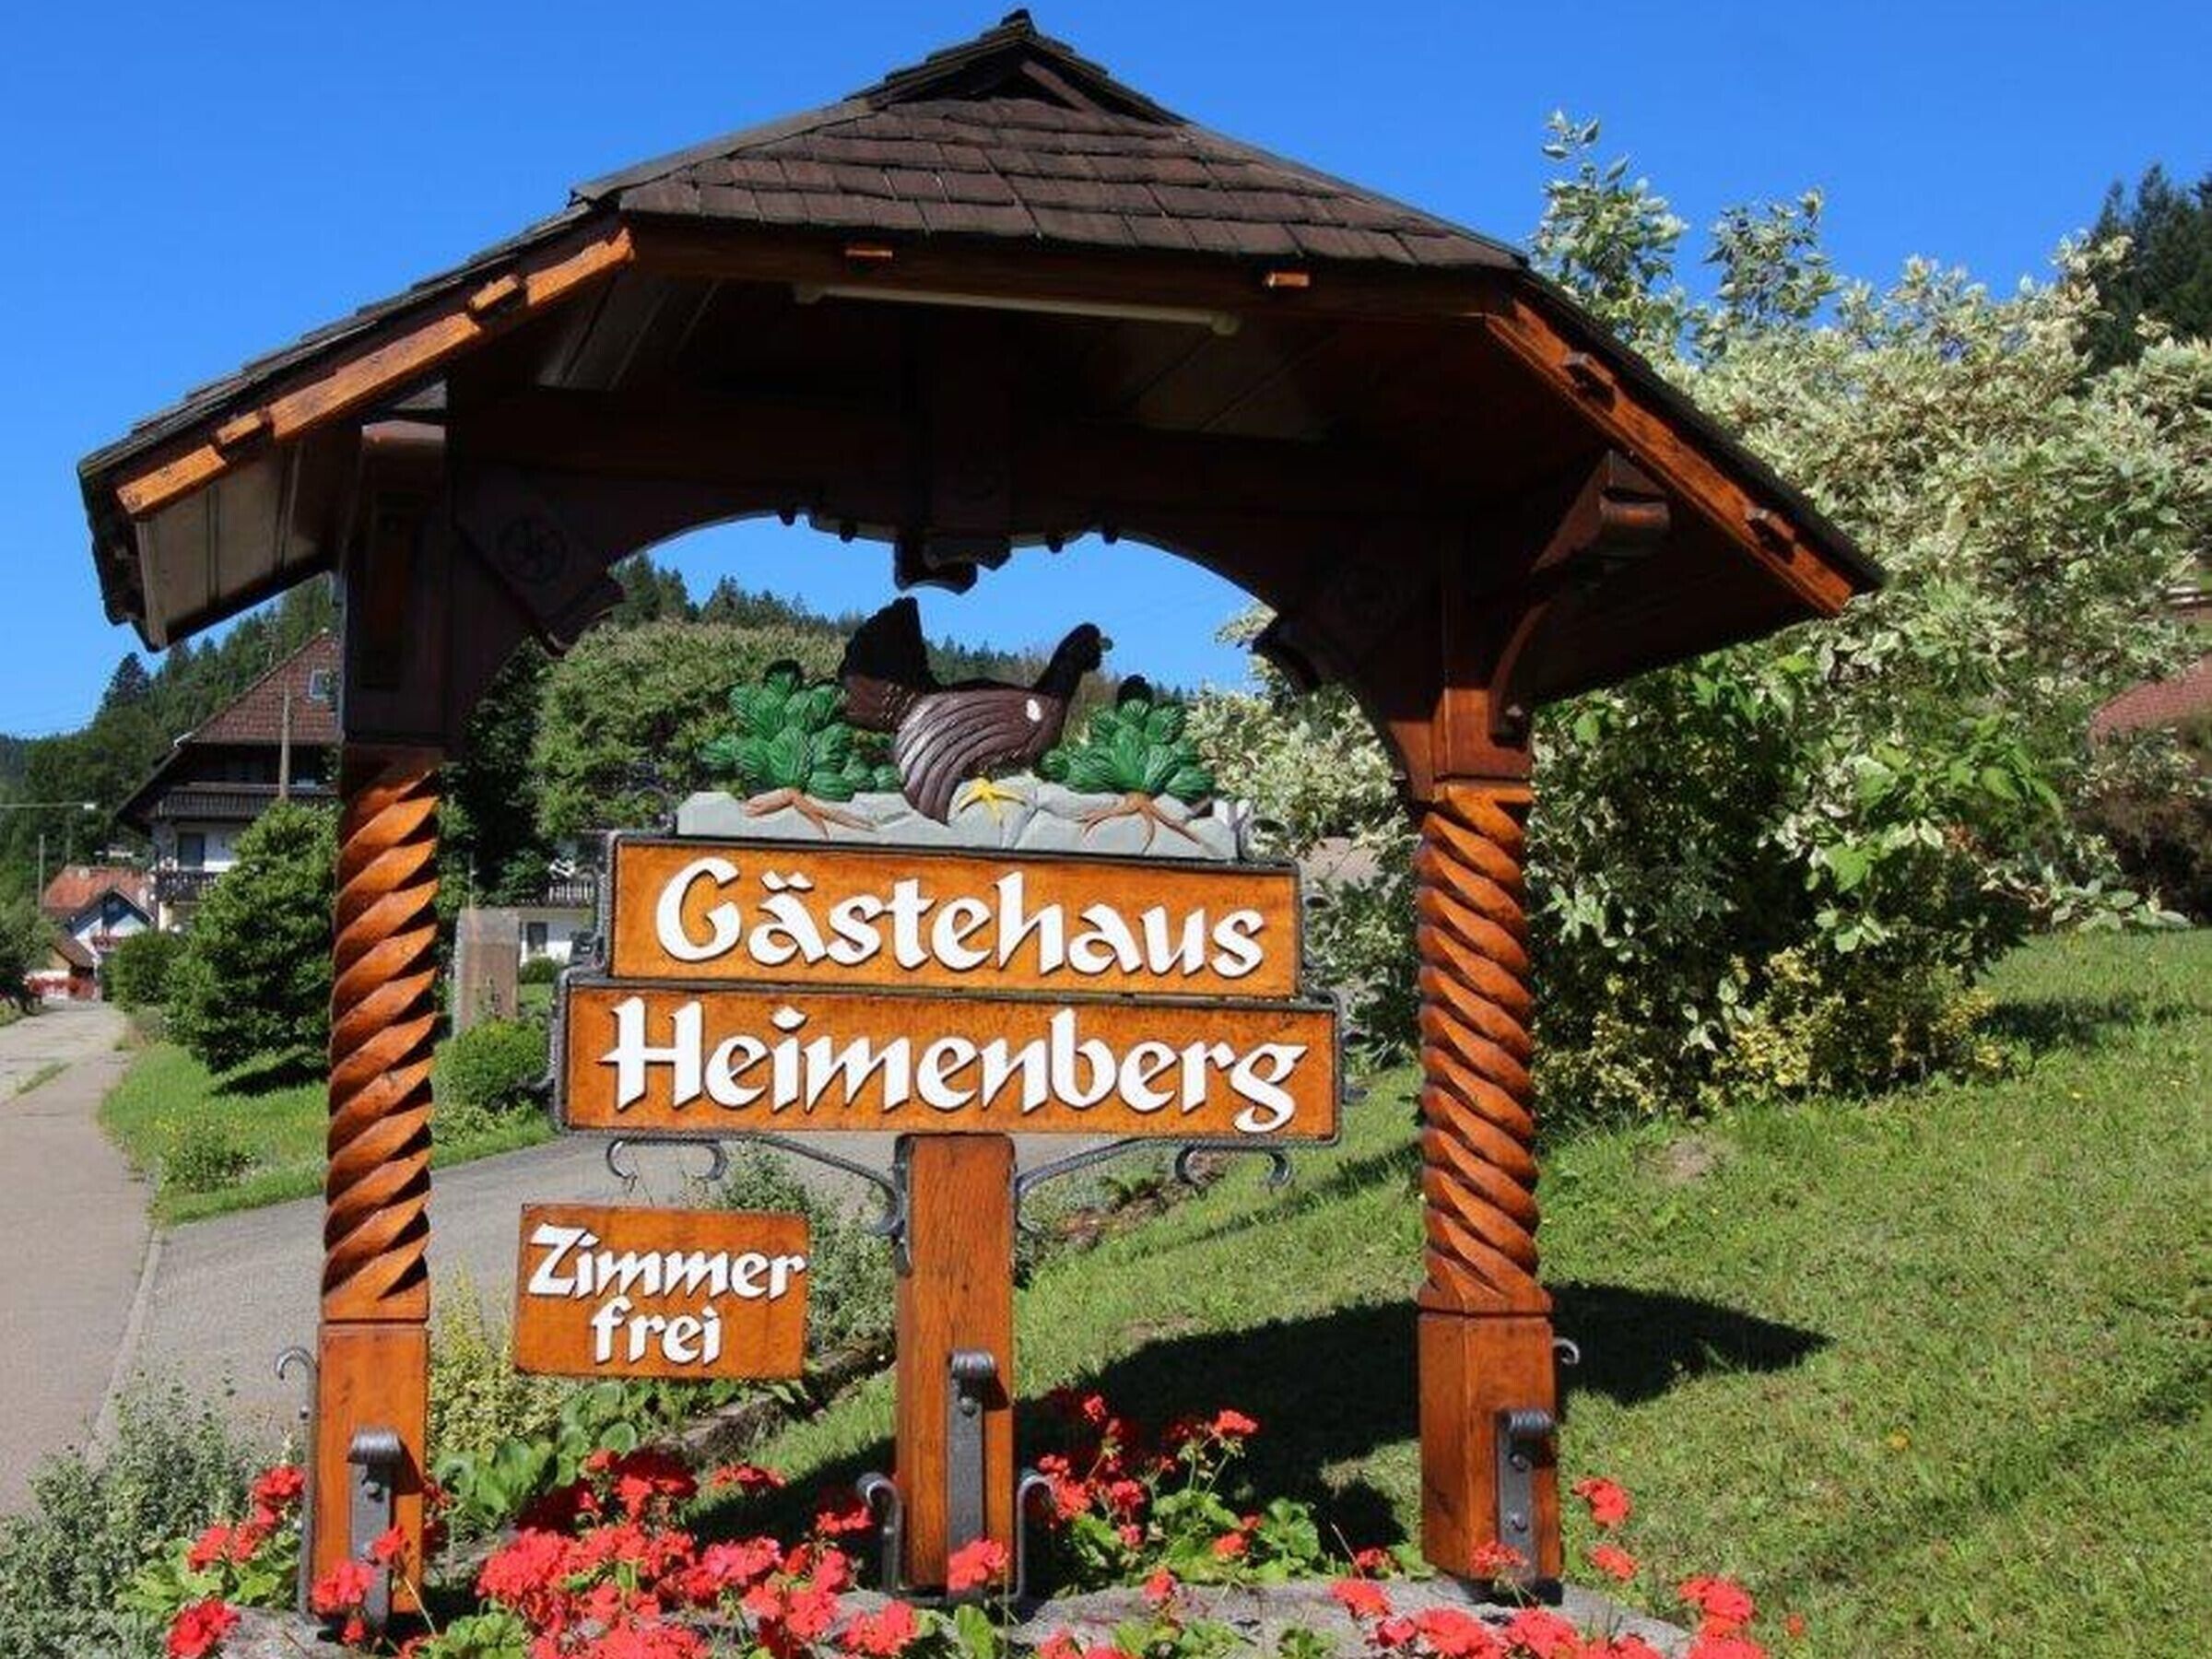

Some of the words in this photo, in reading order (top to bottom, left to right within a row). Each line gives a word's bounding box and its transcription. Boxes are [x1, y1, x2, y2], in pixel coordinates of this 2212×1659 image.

[655, 856, 1265, 977] Gästehaus
[602, 996, 1307, 1133] Heimenberg
[527, 1223, 807, 1302] Zimmer
[591, 1297, 721, 1364] frei
